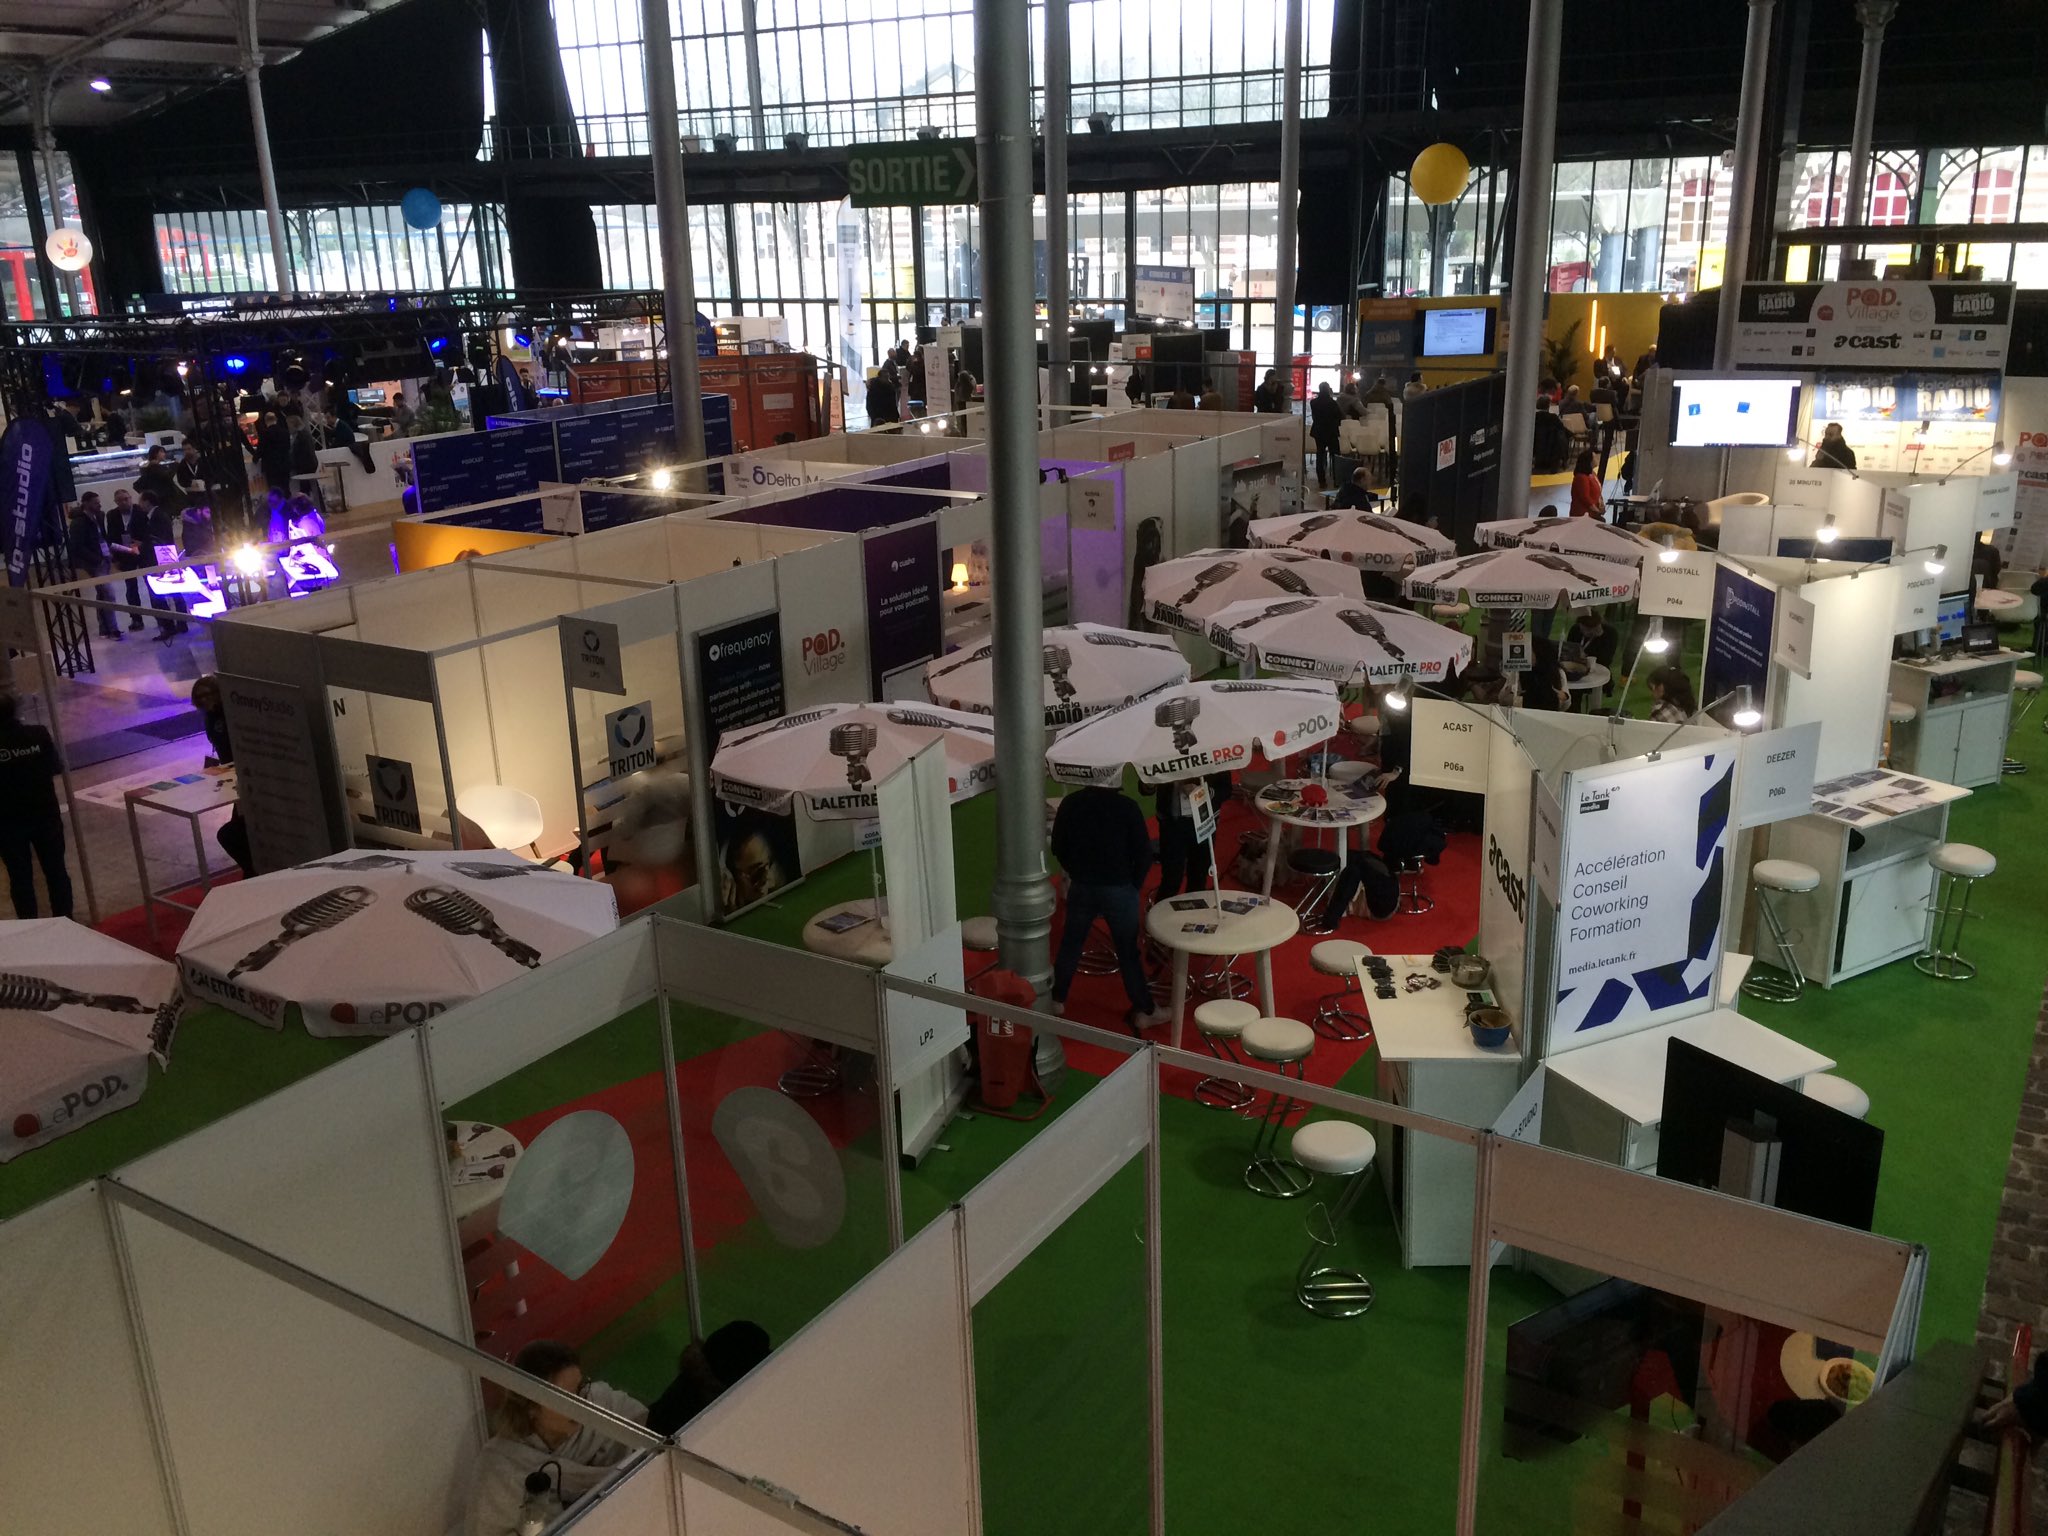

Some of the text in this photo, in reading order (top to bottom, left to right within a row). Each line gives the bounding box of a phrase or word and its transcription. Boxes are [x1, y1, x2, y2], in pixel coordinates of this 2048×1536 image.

[850, 155, 950, 195] SORTIE
[1758, 297, 1796, 314] RADIO
[1847, 288, 1902, 306] POD.
[1953, 297, 1995, 313] RADIO
[1847, 305, 1901, 322] Village
[1834, 333, 1902, 349] acast
[1825, 386, 1896, 418] RADIO
[1917, 387, 1991, 419] RADIO
[461, 456, 484, 465] PODCAST
[564, 459, 593, 468] AUTOMATION
[495, 470, 527, 481] AUTOMATION
[767, 472, 800, 487] Delta
[1797, 479, 1823, 487] MINUTES
[1656, 566, 1700, 576] PODINSTALL
[880, 598, 888, 606] La
[889, 591, 912, 603] solution
[1476, 593, 1550, 602] CONNECT ONAIR
[1571, 584, 1630, 601] LALETTRE.PRO
[1666, 597, 1683, 606] P04a
[1734, 597, 1760, 617] PODINSTALL
[880, 607, 893, 619] pour
[894, 603, 905, 612] vos
[1152, 606, 1184, 628] RADIO
[719, 631, 772, 657] frequency
[802, 628, 846, 661] POD.
[1209, 627, 1234, 653] RADIO
[581, 653, 606, 666] TRITON
[759, 663, 772, 671] now
[803, 652, 846, 676] Village
[1266, 654, 1314, 670] CONNECT
[1315, 661, 1345, 674] ONAIR
[1369, 661, 1441, 676] LALETTRE.PRO
[333, 698, 346, 717] N
[719, 698, 740, 712] provide
[740, 687, 770, 704] publishers
[1057, 702, 1070, 711] de
[1071, 701, 1080, 709] la
[1442, 721, 1473, 733] ACAST
[12, 743, 41, 758] VoxM
[1766, 749, 1796, 764] DEEZER
[610, 748, 655, 777] TRITON
[1143, 744, 1245, 777] LALETTRE.PRO
[1443, 761, 1465, 773] P06a
[722, 781, 761, 799] CONNECT
[1580, 788, 1610, 803] Le Tank
[1768, 786, 1786, 798] P06b
[374, 803, 421, 830] TRITON
[1580, 803, 1601, 813] media
[1574, 847, 1666, 878] Accélération
[1489, 833, 1526, 924] acast
[1573, 875, 1628, 899] Conseil
[1571, 893, 1649, 922] Coworking
[1569, 915, 1641, 943] Formation
[1568, 951, 1637, 976] media.letank.fr
[919, 1028, 934, 1047] LP2
